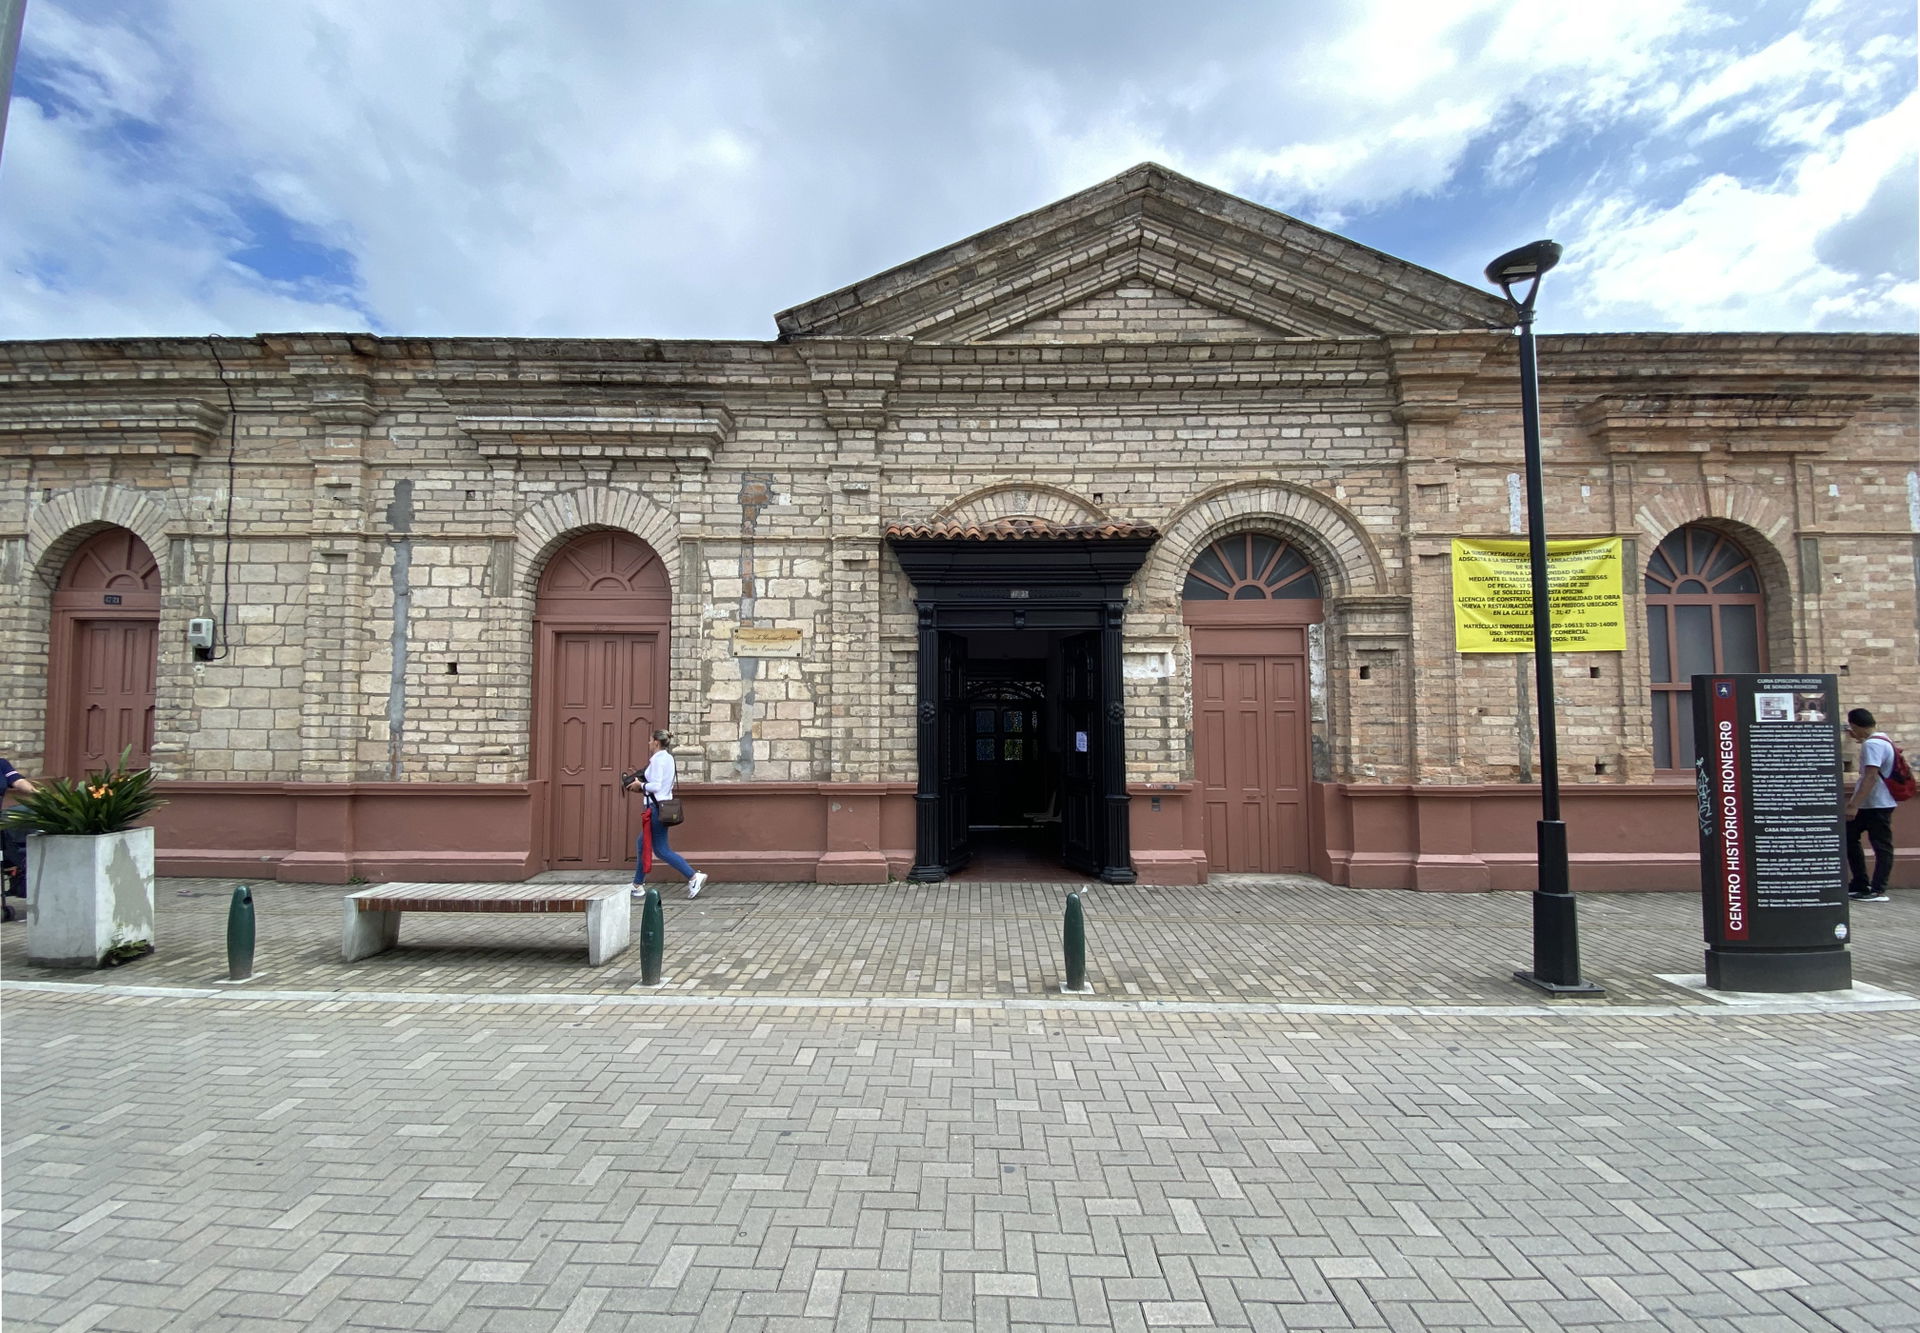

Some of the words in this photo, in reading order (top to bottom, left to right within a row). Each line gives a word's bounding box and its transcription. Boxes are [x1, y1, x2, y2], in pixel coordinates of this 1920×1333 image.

[1719, 721, 1736, 793] RIONEGRO
[1723, 795, 1740, 871] HISTÓRICO
[1728, 873, 1742, 931] CENTRO
